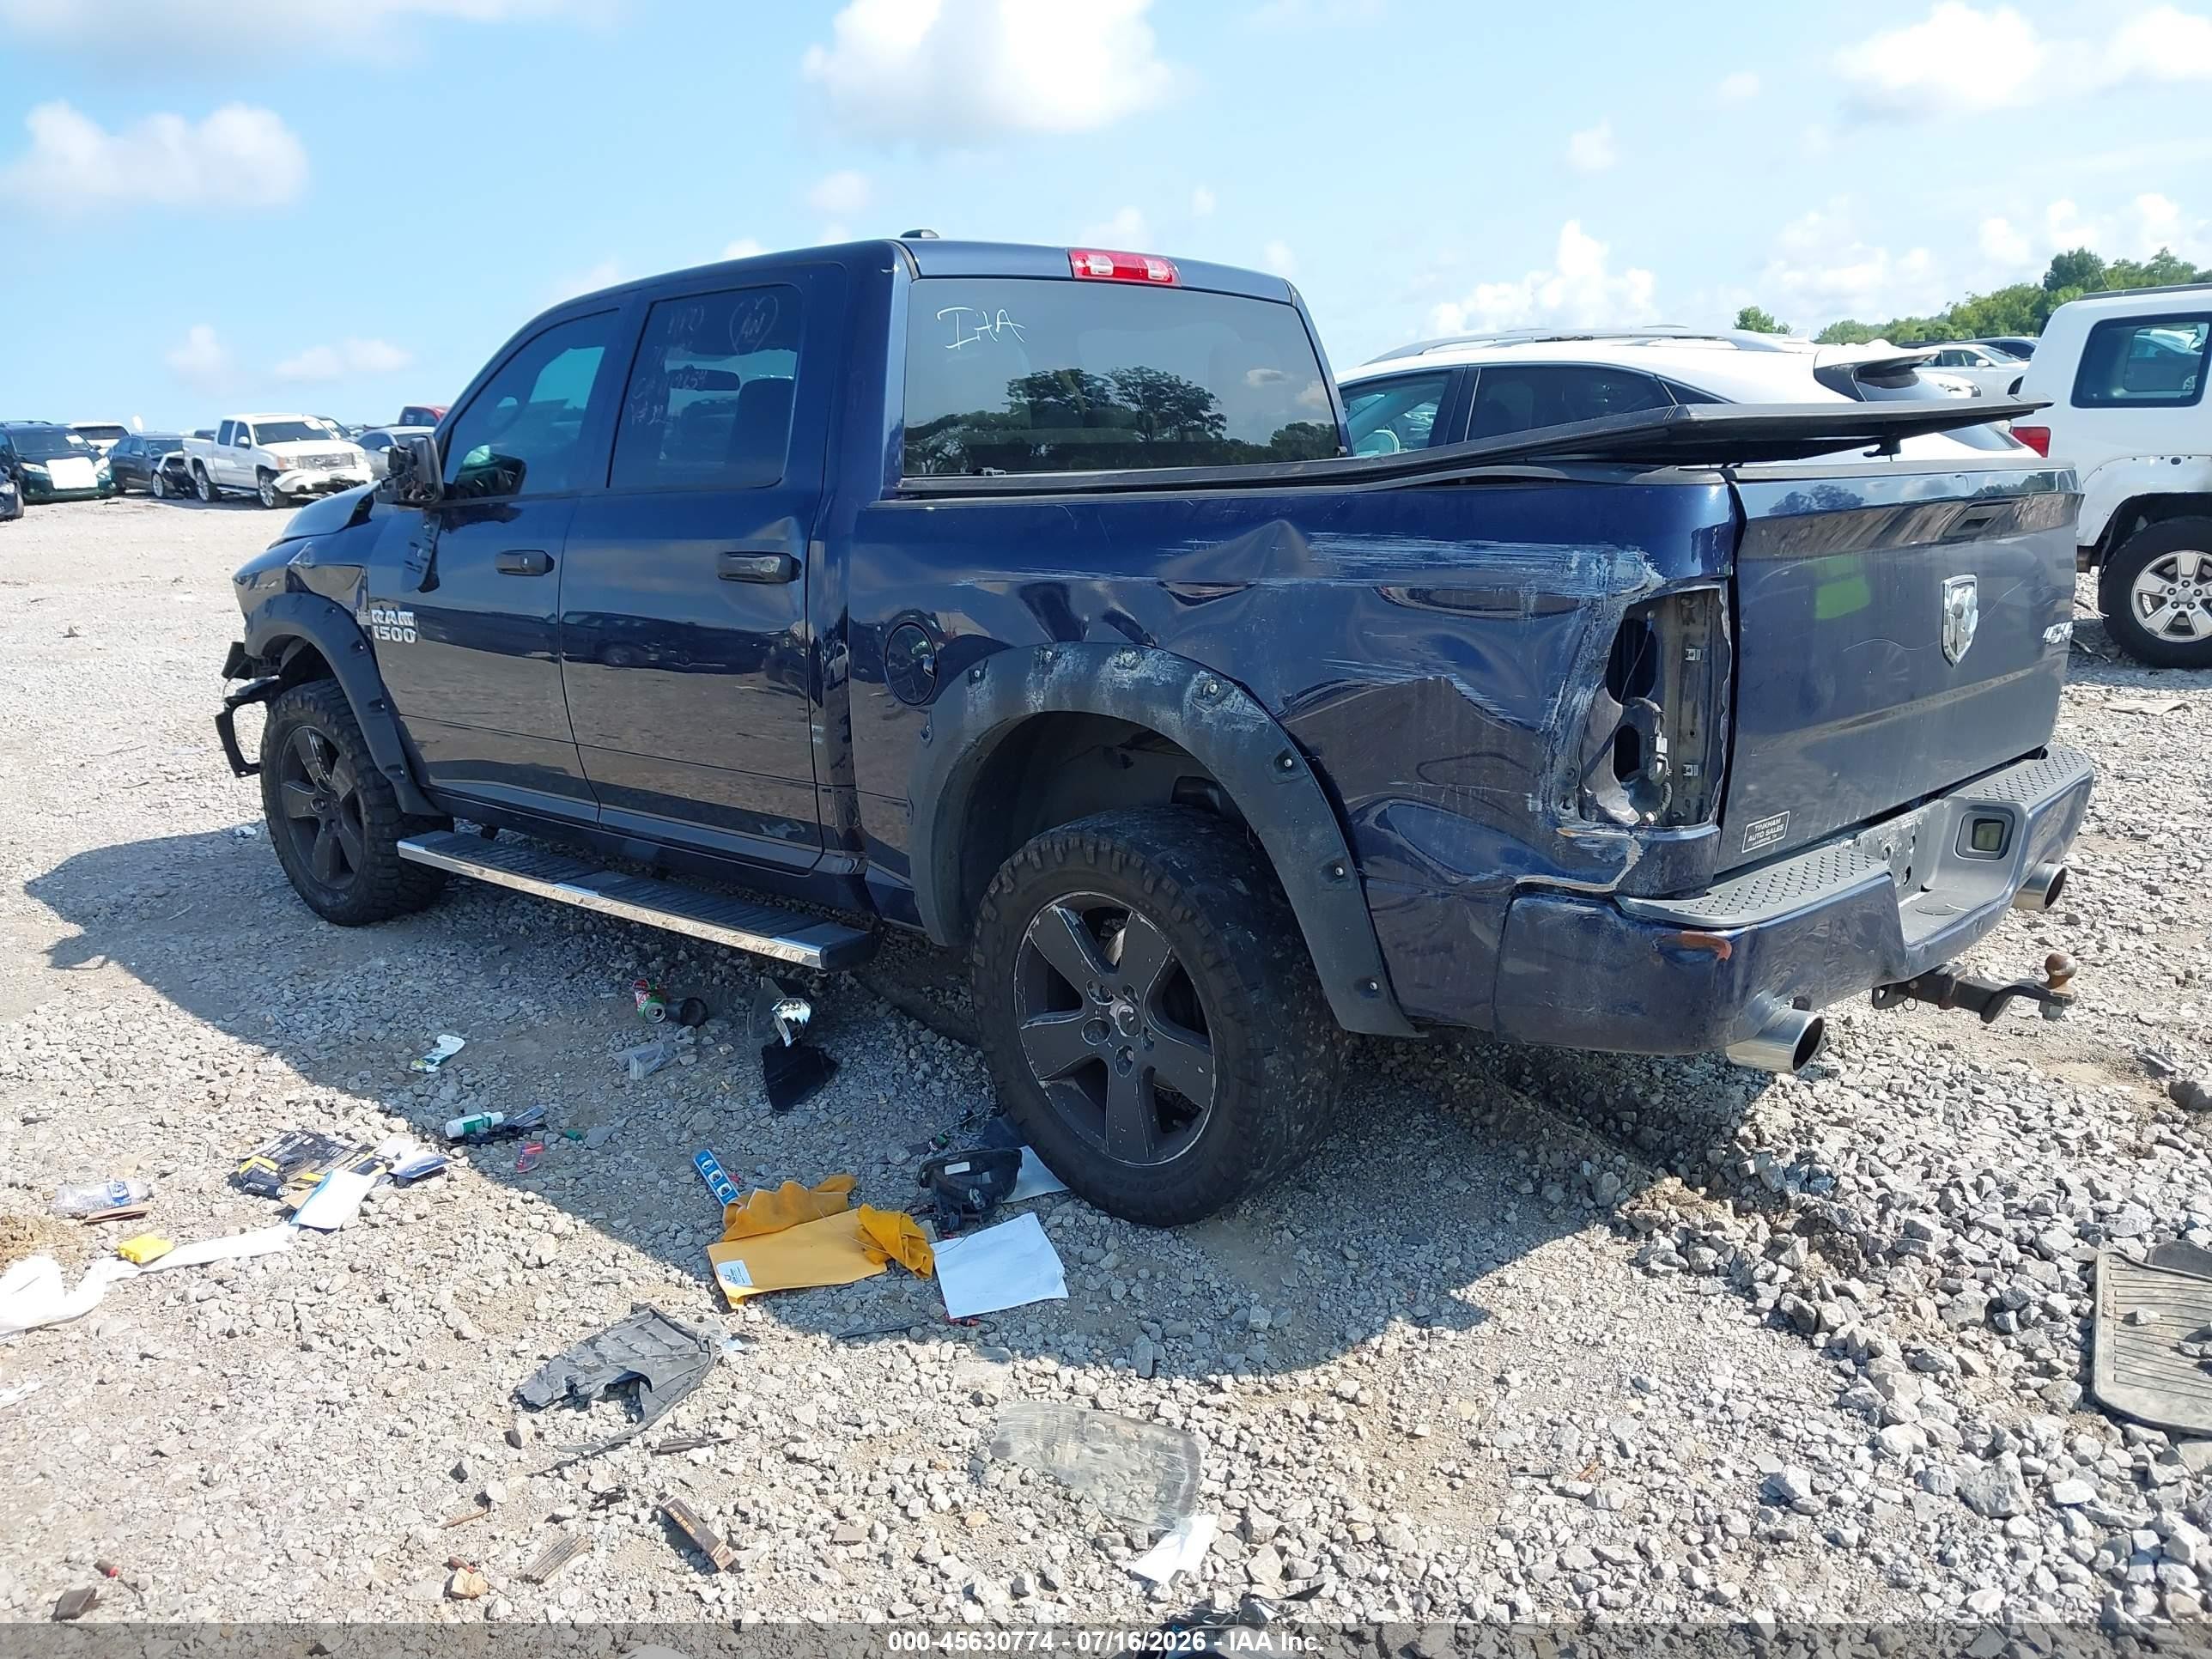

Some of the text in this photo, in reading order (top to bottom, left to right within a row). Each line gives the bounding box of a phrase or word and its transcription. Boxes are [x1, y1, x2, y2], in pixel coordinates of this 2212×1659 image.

[371, 609, 414, 626] RAM
[373, 625, 416, 644] 1500
[1747, 830, 1765, 842] AUTO
[1765, 823, 1785, 836] SALES
